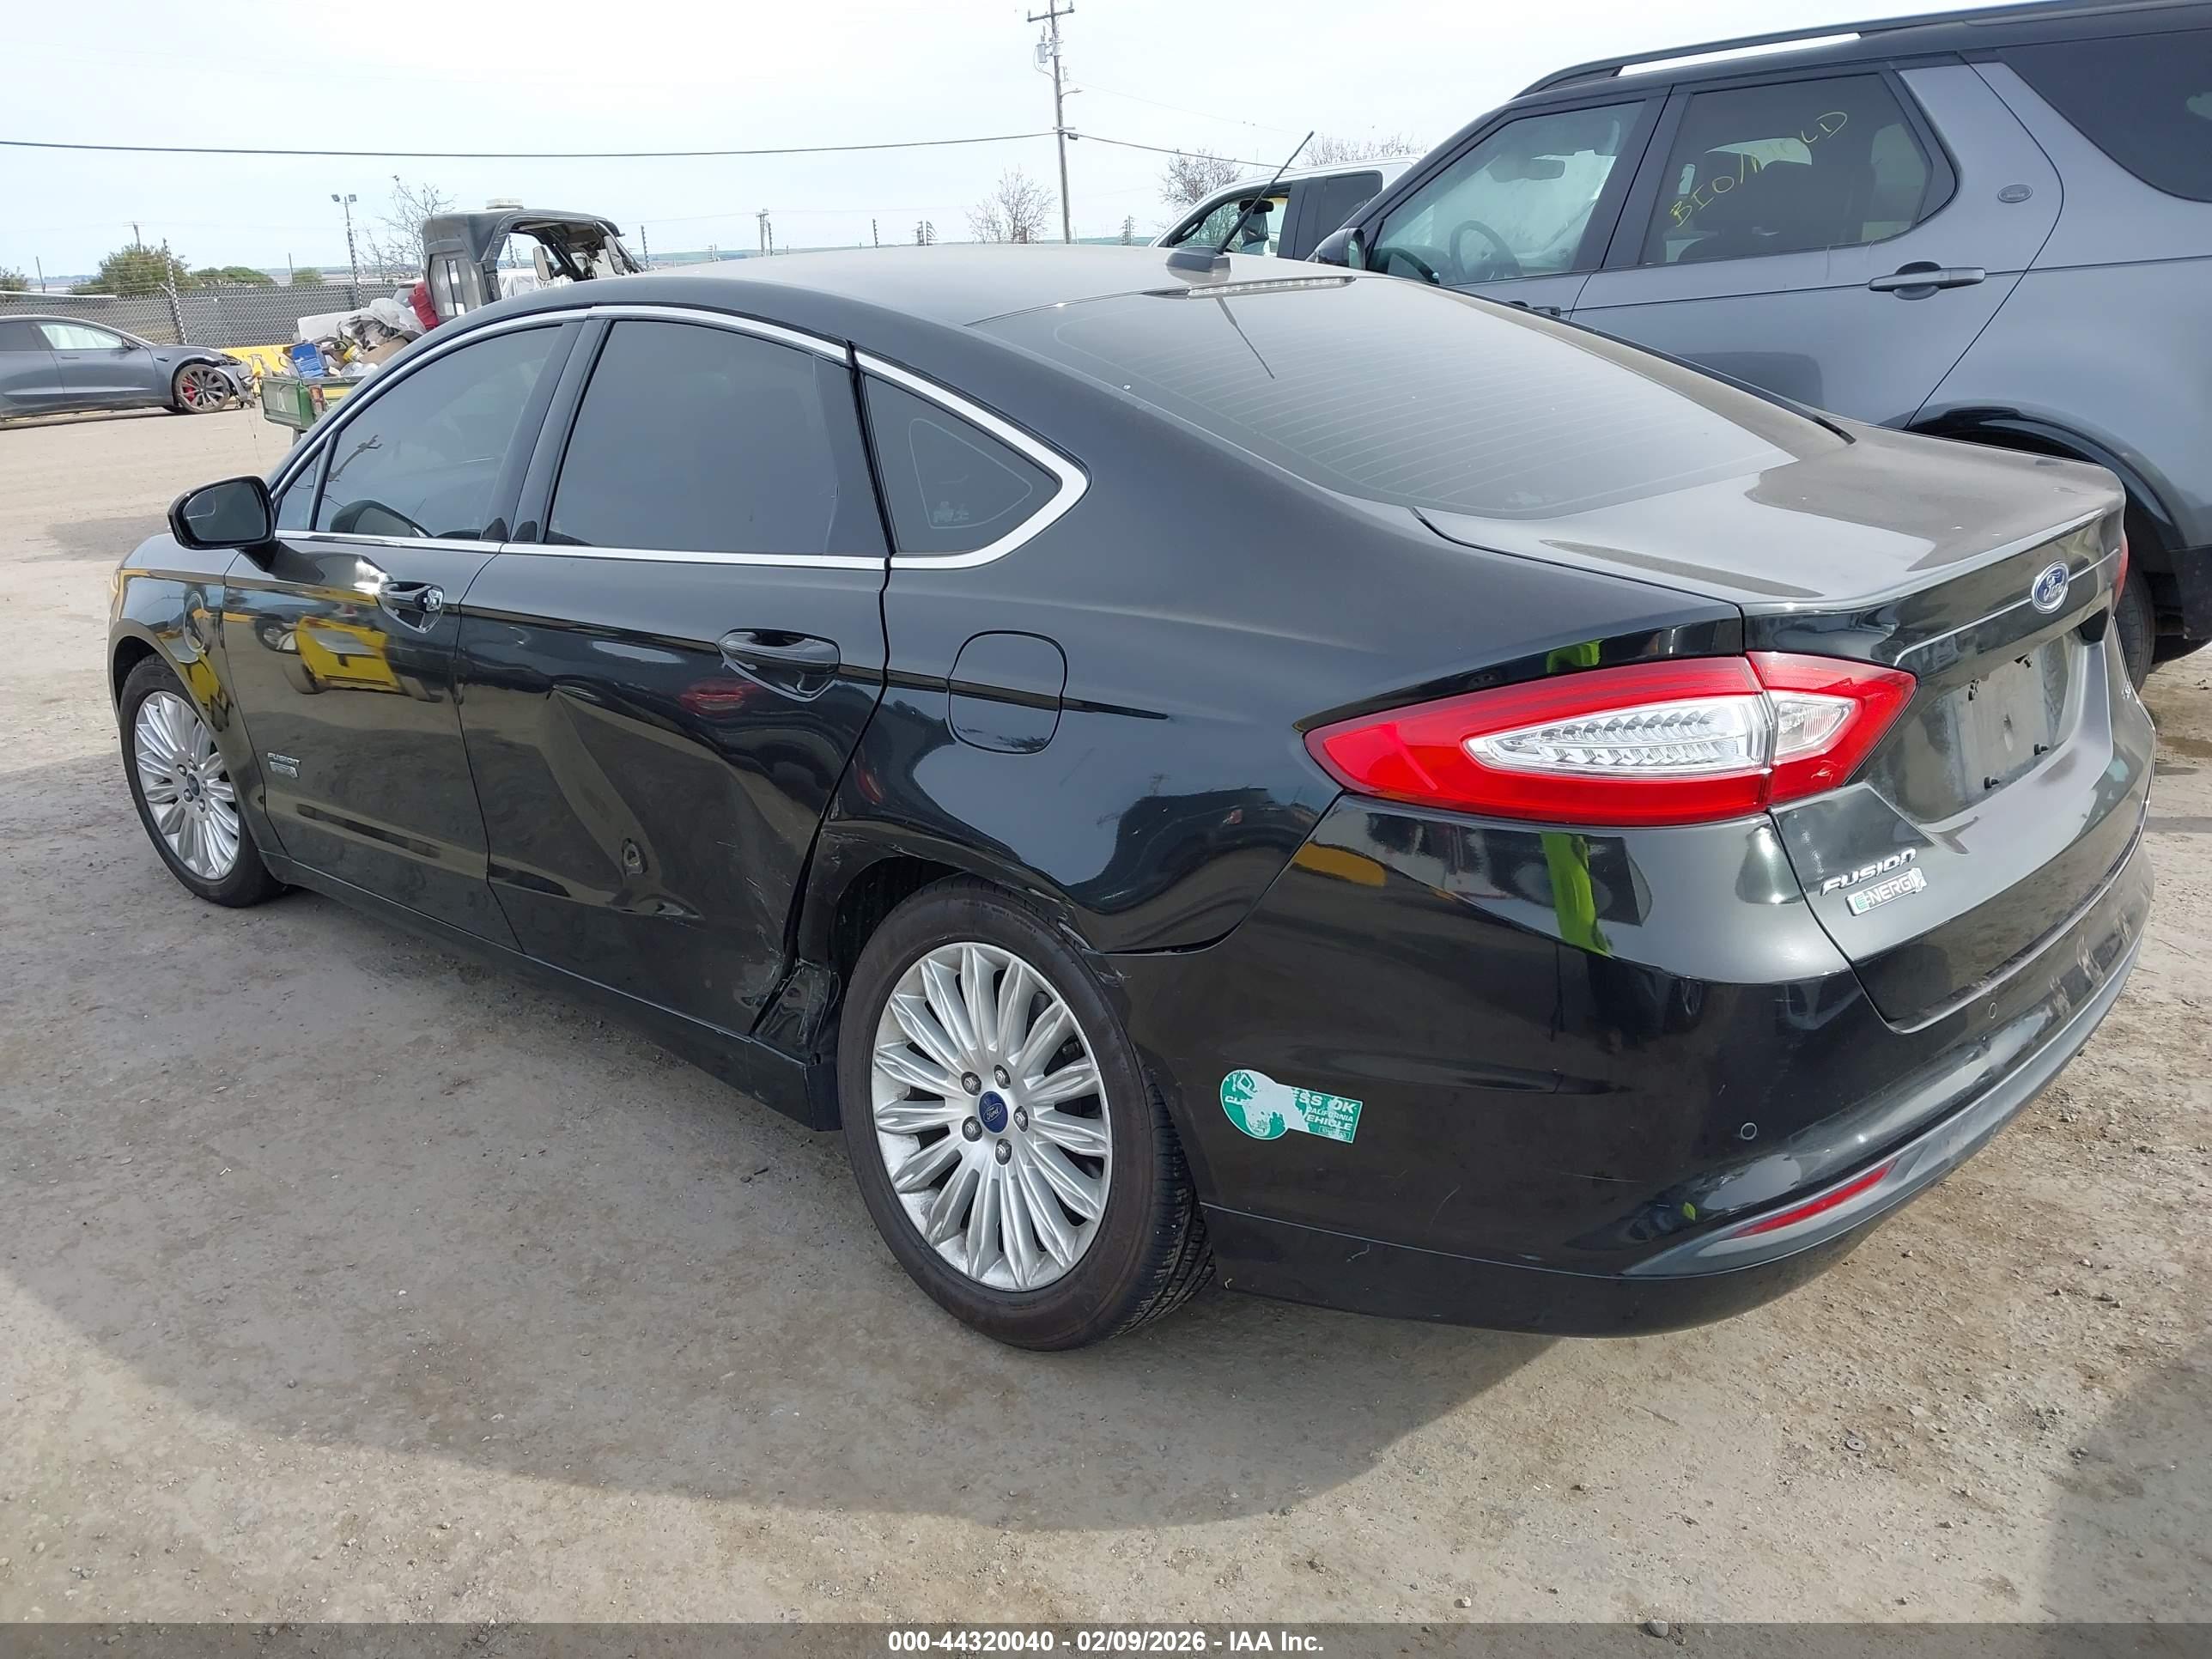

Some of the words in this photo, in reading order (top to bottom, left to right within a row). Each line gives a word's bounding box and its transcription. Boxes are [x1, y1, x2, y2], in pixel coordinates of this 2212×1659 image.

[1820, 848, 1917, 896] FUSION
[1328, 1097, 1357, 1115] OK
[1305, 1114, 1353, 1131] EHICLE
